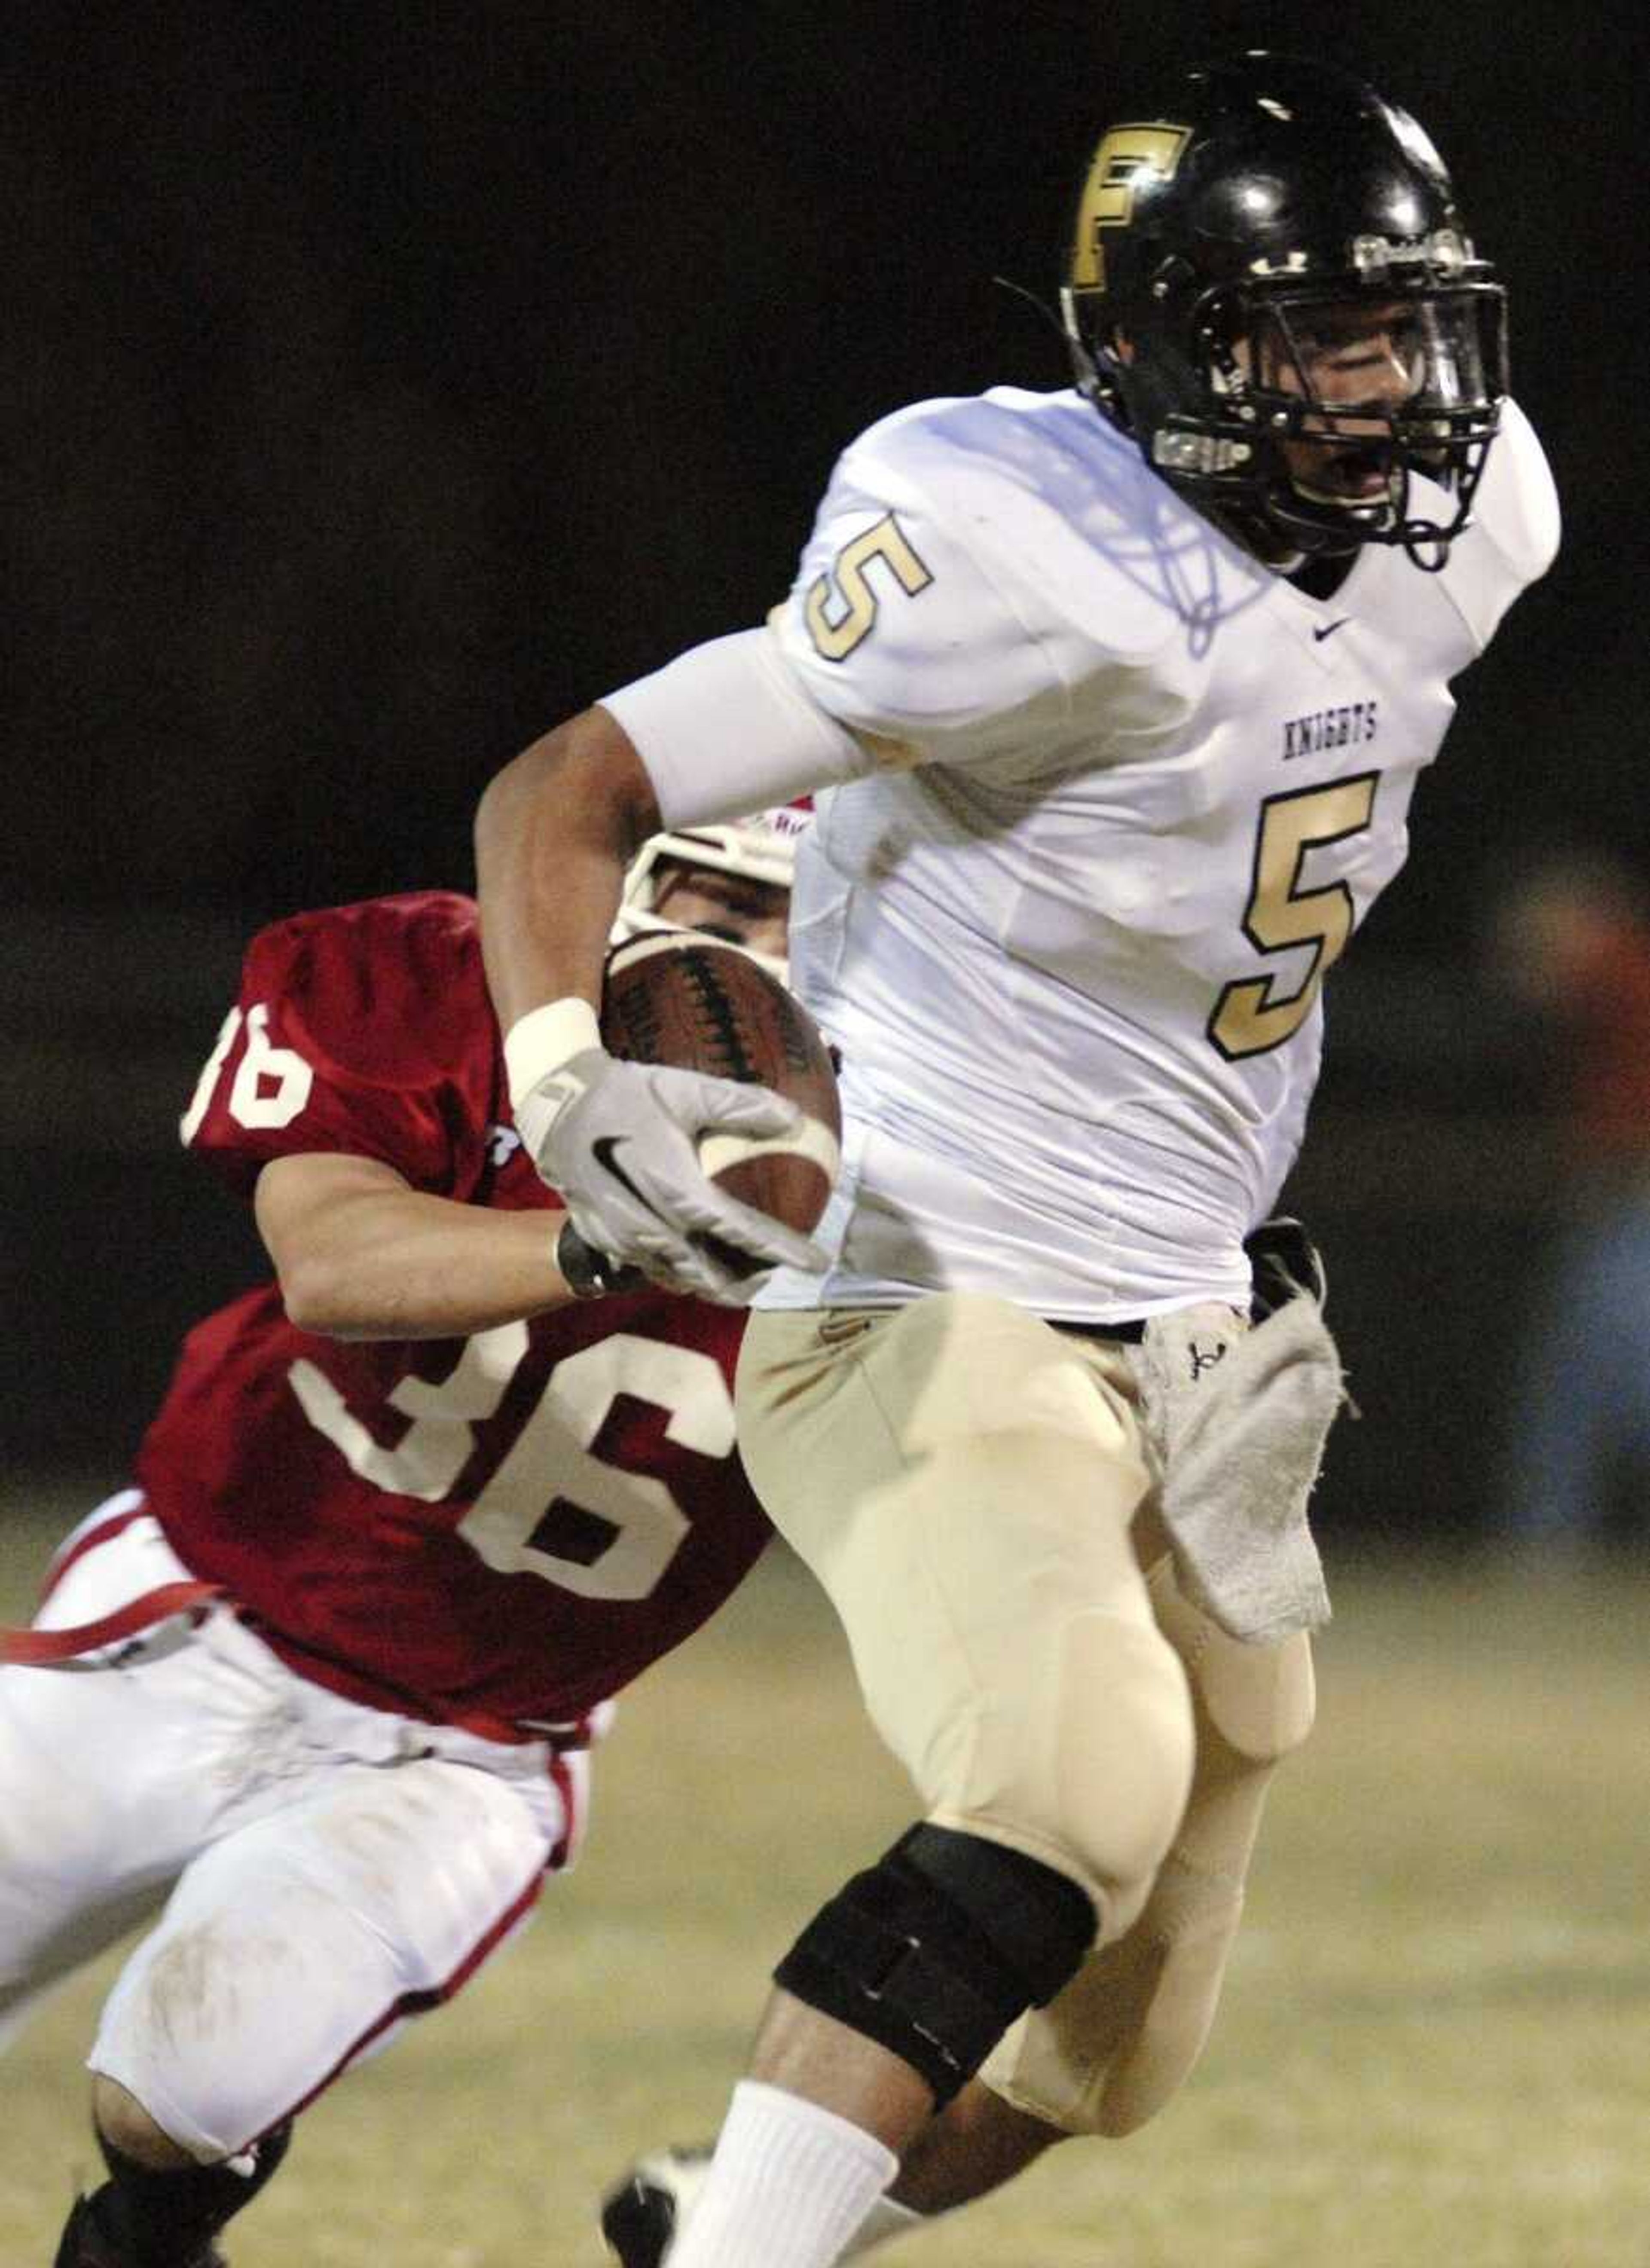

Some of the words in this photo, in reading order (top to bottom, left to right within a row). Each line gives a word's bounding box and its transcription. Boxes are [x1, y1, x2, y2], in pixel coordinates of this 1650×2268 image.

[1073, 122, 1195, 294] F
[804, 508, 936, 663] 5
[1283, 701, 1377, 761] KNIGHTS
[1207, 769, 1381, 1062] 5
[287, 1320, 736, 1601] 36
